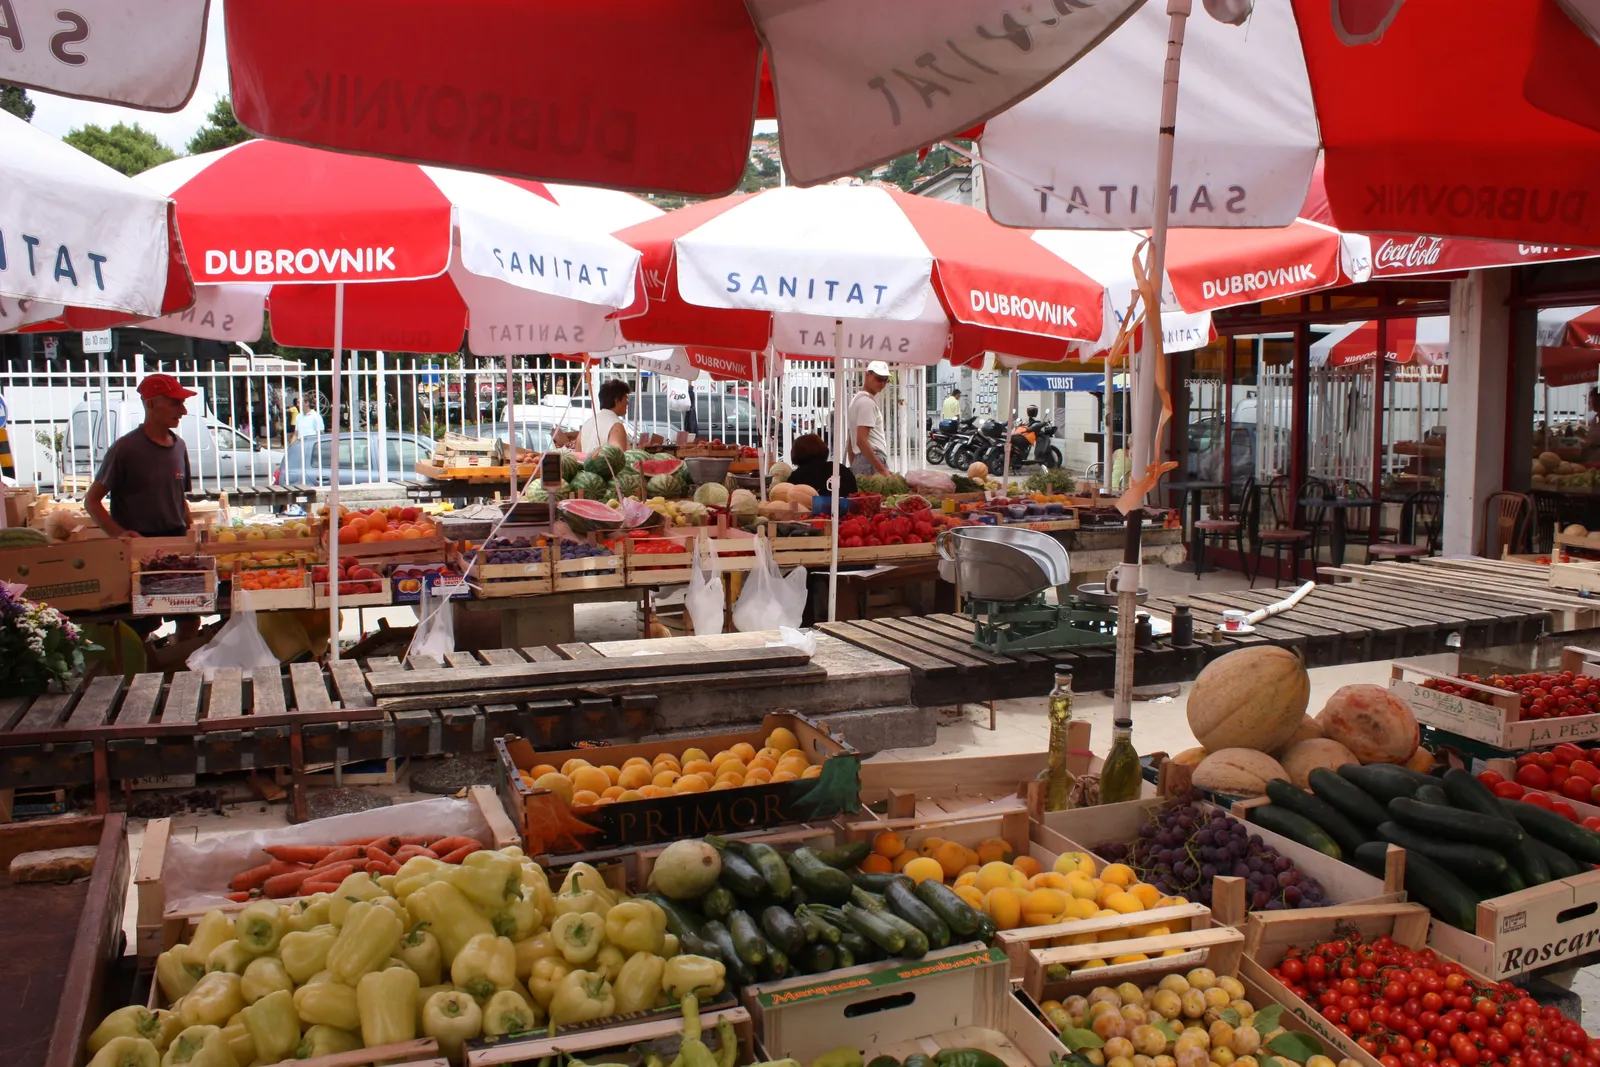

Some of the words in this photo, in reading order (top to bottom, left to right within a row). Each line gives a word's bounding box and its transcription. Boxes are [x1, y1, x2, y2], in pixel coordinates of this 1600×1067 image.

[205, 247, 395, 275] DUBROVNIK
[1374, 235, 1444, 269] Coca-Cola
[493, 248, 608, 286] SANITAT
[726, 272, 888, 305] SANITAT
[1203, 263, 1317, 300] DUBROVNIK
[970, 279, 1078, 328] DUBROVNIK
[695, 353, 746, 375] DUBROVNIK
[1047, 377, 1074, 390] TURIST
[1184, 379, 1221, 389] ESPRESSO
[1531, 727, 1552, 741] LA
[619, 794, 788, 842] PRIMOR
[897, 952, 992, 979] Marquesa
[773, 978, 872, 1005] Marquesa
